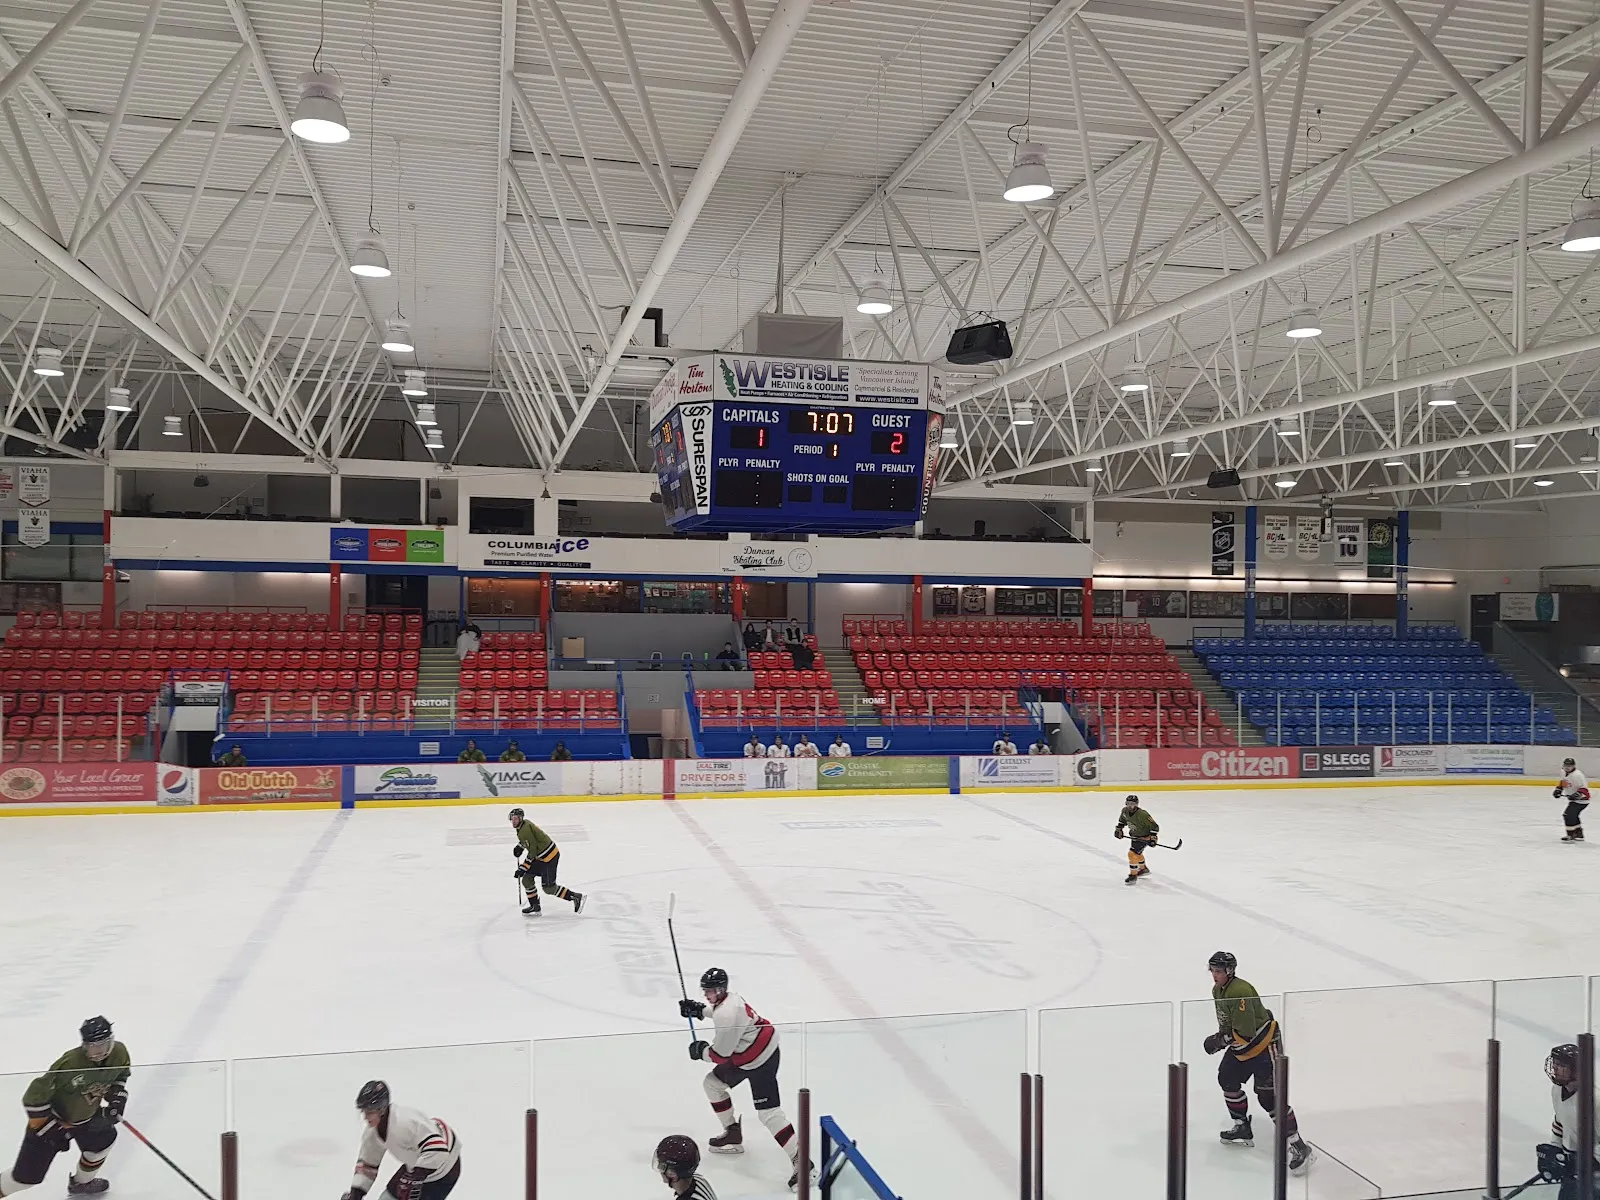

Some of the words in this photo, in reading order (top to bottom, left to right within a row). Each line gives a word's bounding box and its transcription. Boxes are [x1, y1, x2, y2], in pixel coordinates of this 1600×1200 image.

[688, 364, 704, 379] Tim
[733, 360, 849, 388] WESTISLE
[895, 369, 918, 377] Serving
[771, 380, 804, 390] HEATING
[814, 383, 849, 392] COOLING
[860, 375, 893, 384] Vancouver
[679, 380, 713, 394] Hortons
[855, 384, 885, 393] Commercial
[892, 386, 919, 394] Residential
[860, 396, 914, 404] www.westisle.ca
[722, 408, 780, 423] CAPITALS
[807, 411, 853, 433] 7:07
[872, 414, 911, 428] GUEST
[759, 429, 764, 447] 1
[891, 433, 903, 453] 2
[793, 444, 823, 454] PERIOD
[833, 444, 838, 457] 1
[691, 419, 708, 508] SURESPAN
[718, 458, 739, 467] PLYR
[745, 459, 780, 468] PENALTY
[855, 463, 875, 472] PLYR
[881, 463, 915, 473] PENALTY
[787, 473, 813, 482] SHOTS
[815, 474, 827, 483] ON
[828, 475, 849, 483] GOAL
[921, 454, 934, 514] COUNTRY
[488, 540, 557, 550] COLUMBIA
[555, 538, 589, 554] ice
[743, 545, 775, 555] Duncan
[733, 555, 762, 565] Skating
[765, 555, 783, 565] Club
[105, 572, 111, 580] 2
[1201, 750, 1289, 777] Citizen
[1322, 753, 1371, 765] SLEGG
[1077, 756, 1096, 780] G
[1180, 769, 1200, 777] Valley
[52, 769, 78, 783] Your
[80, 769, 108, 783] Local
[219, 771, 249, 790] Old
[250, 771, 297, 790] Dutch
[1239, 998, 1246, 1012] 3
